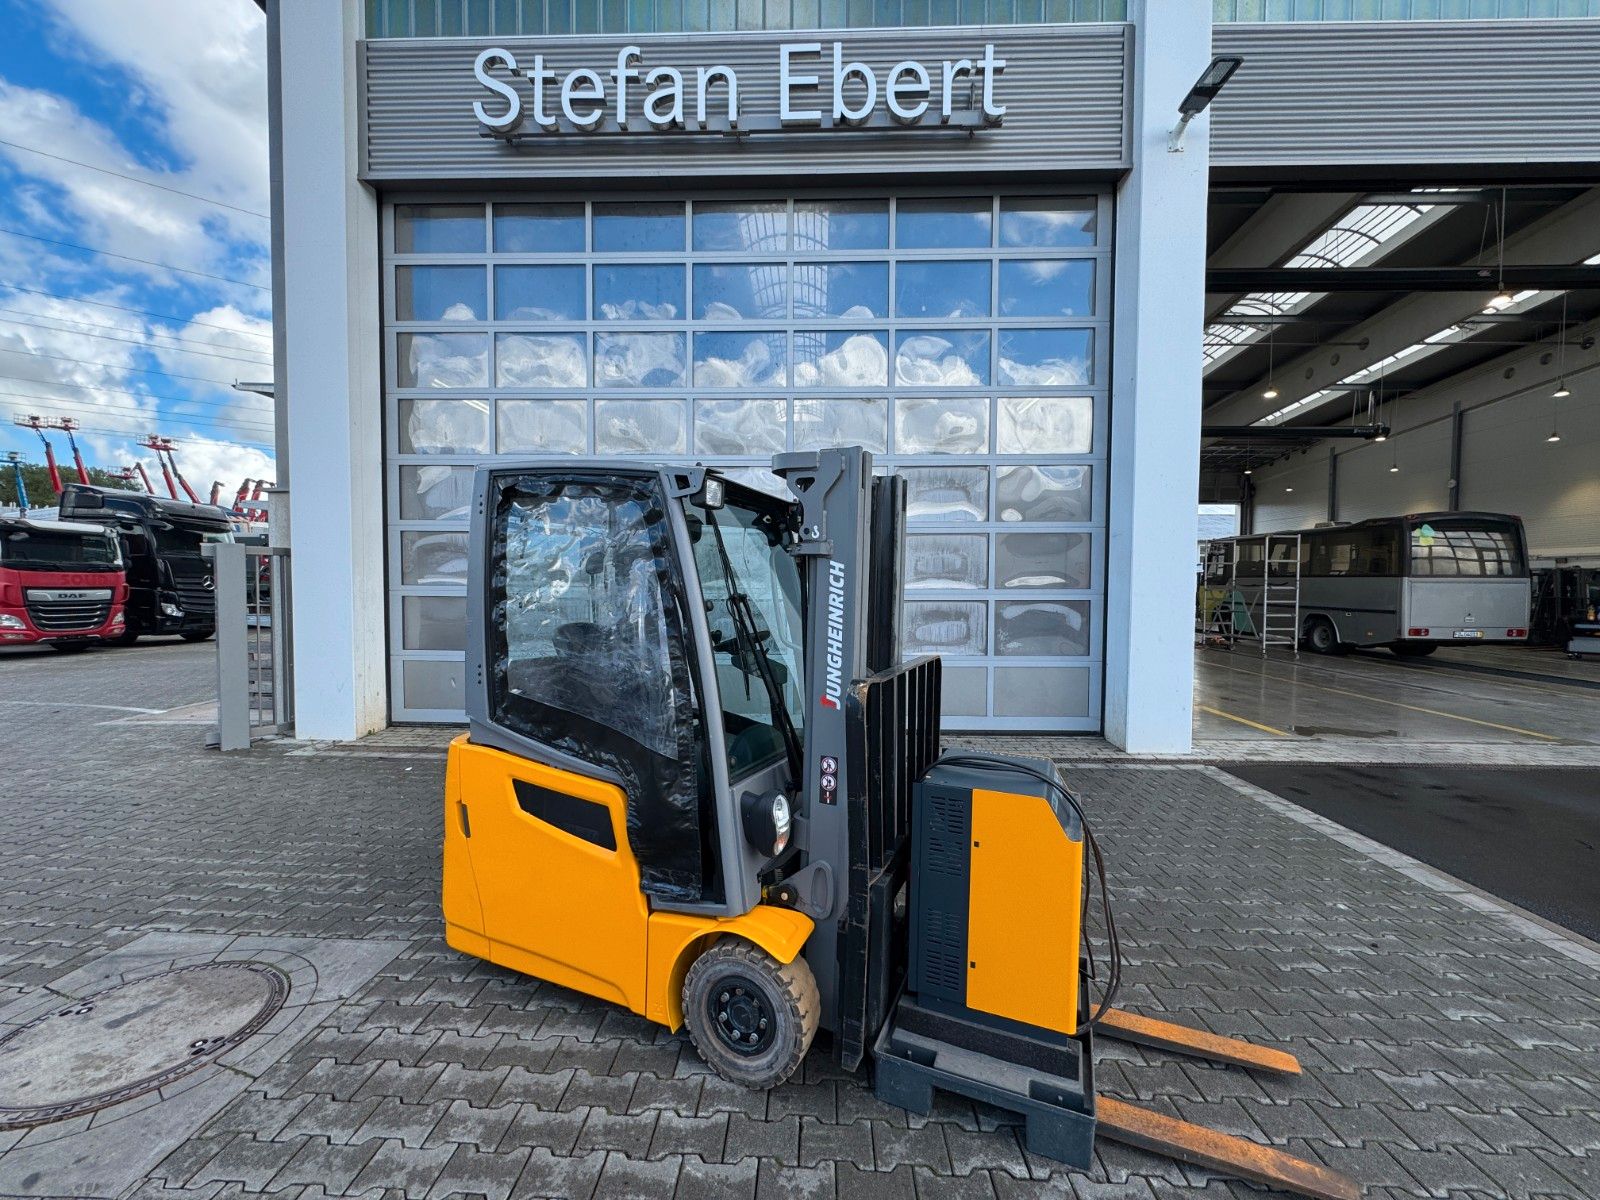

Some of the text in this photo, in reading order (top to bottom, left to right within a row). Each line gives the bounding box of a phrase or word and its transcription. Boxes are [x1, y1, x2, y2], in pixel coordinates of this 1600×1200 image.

[472, 41, 1007, 127] Stefan Ebert
[820, 560, 845, 710] JUNGHEINRICH
